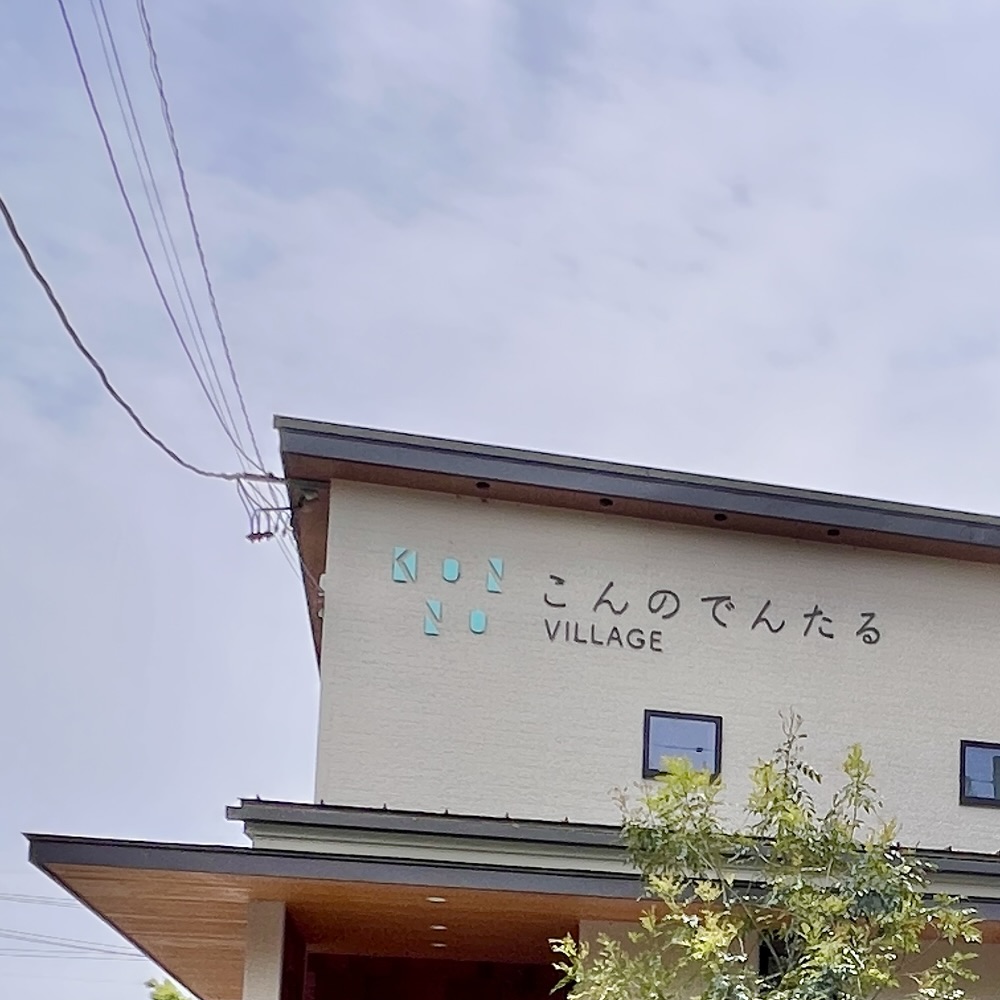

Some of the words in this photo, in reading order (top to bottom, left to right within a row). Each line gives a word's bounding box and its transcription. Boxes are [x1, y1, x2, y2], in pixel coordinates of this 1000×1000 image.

[544, 574, 881, 644] こんのでんたる
[544, 618, 663, 653] VILLAGE
